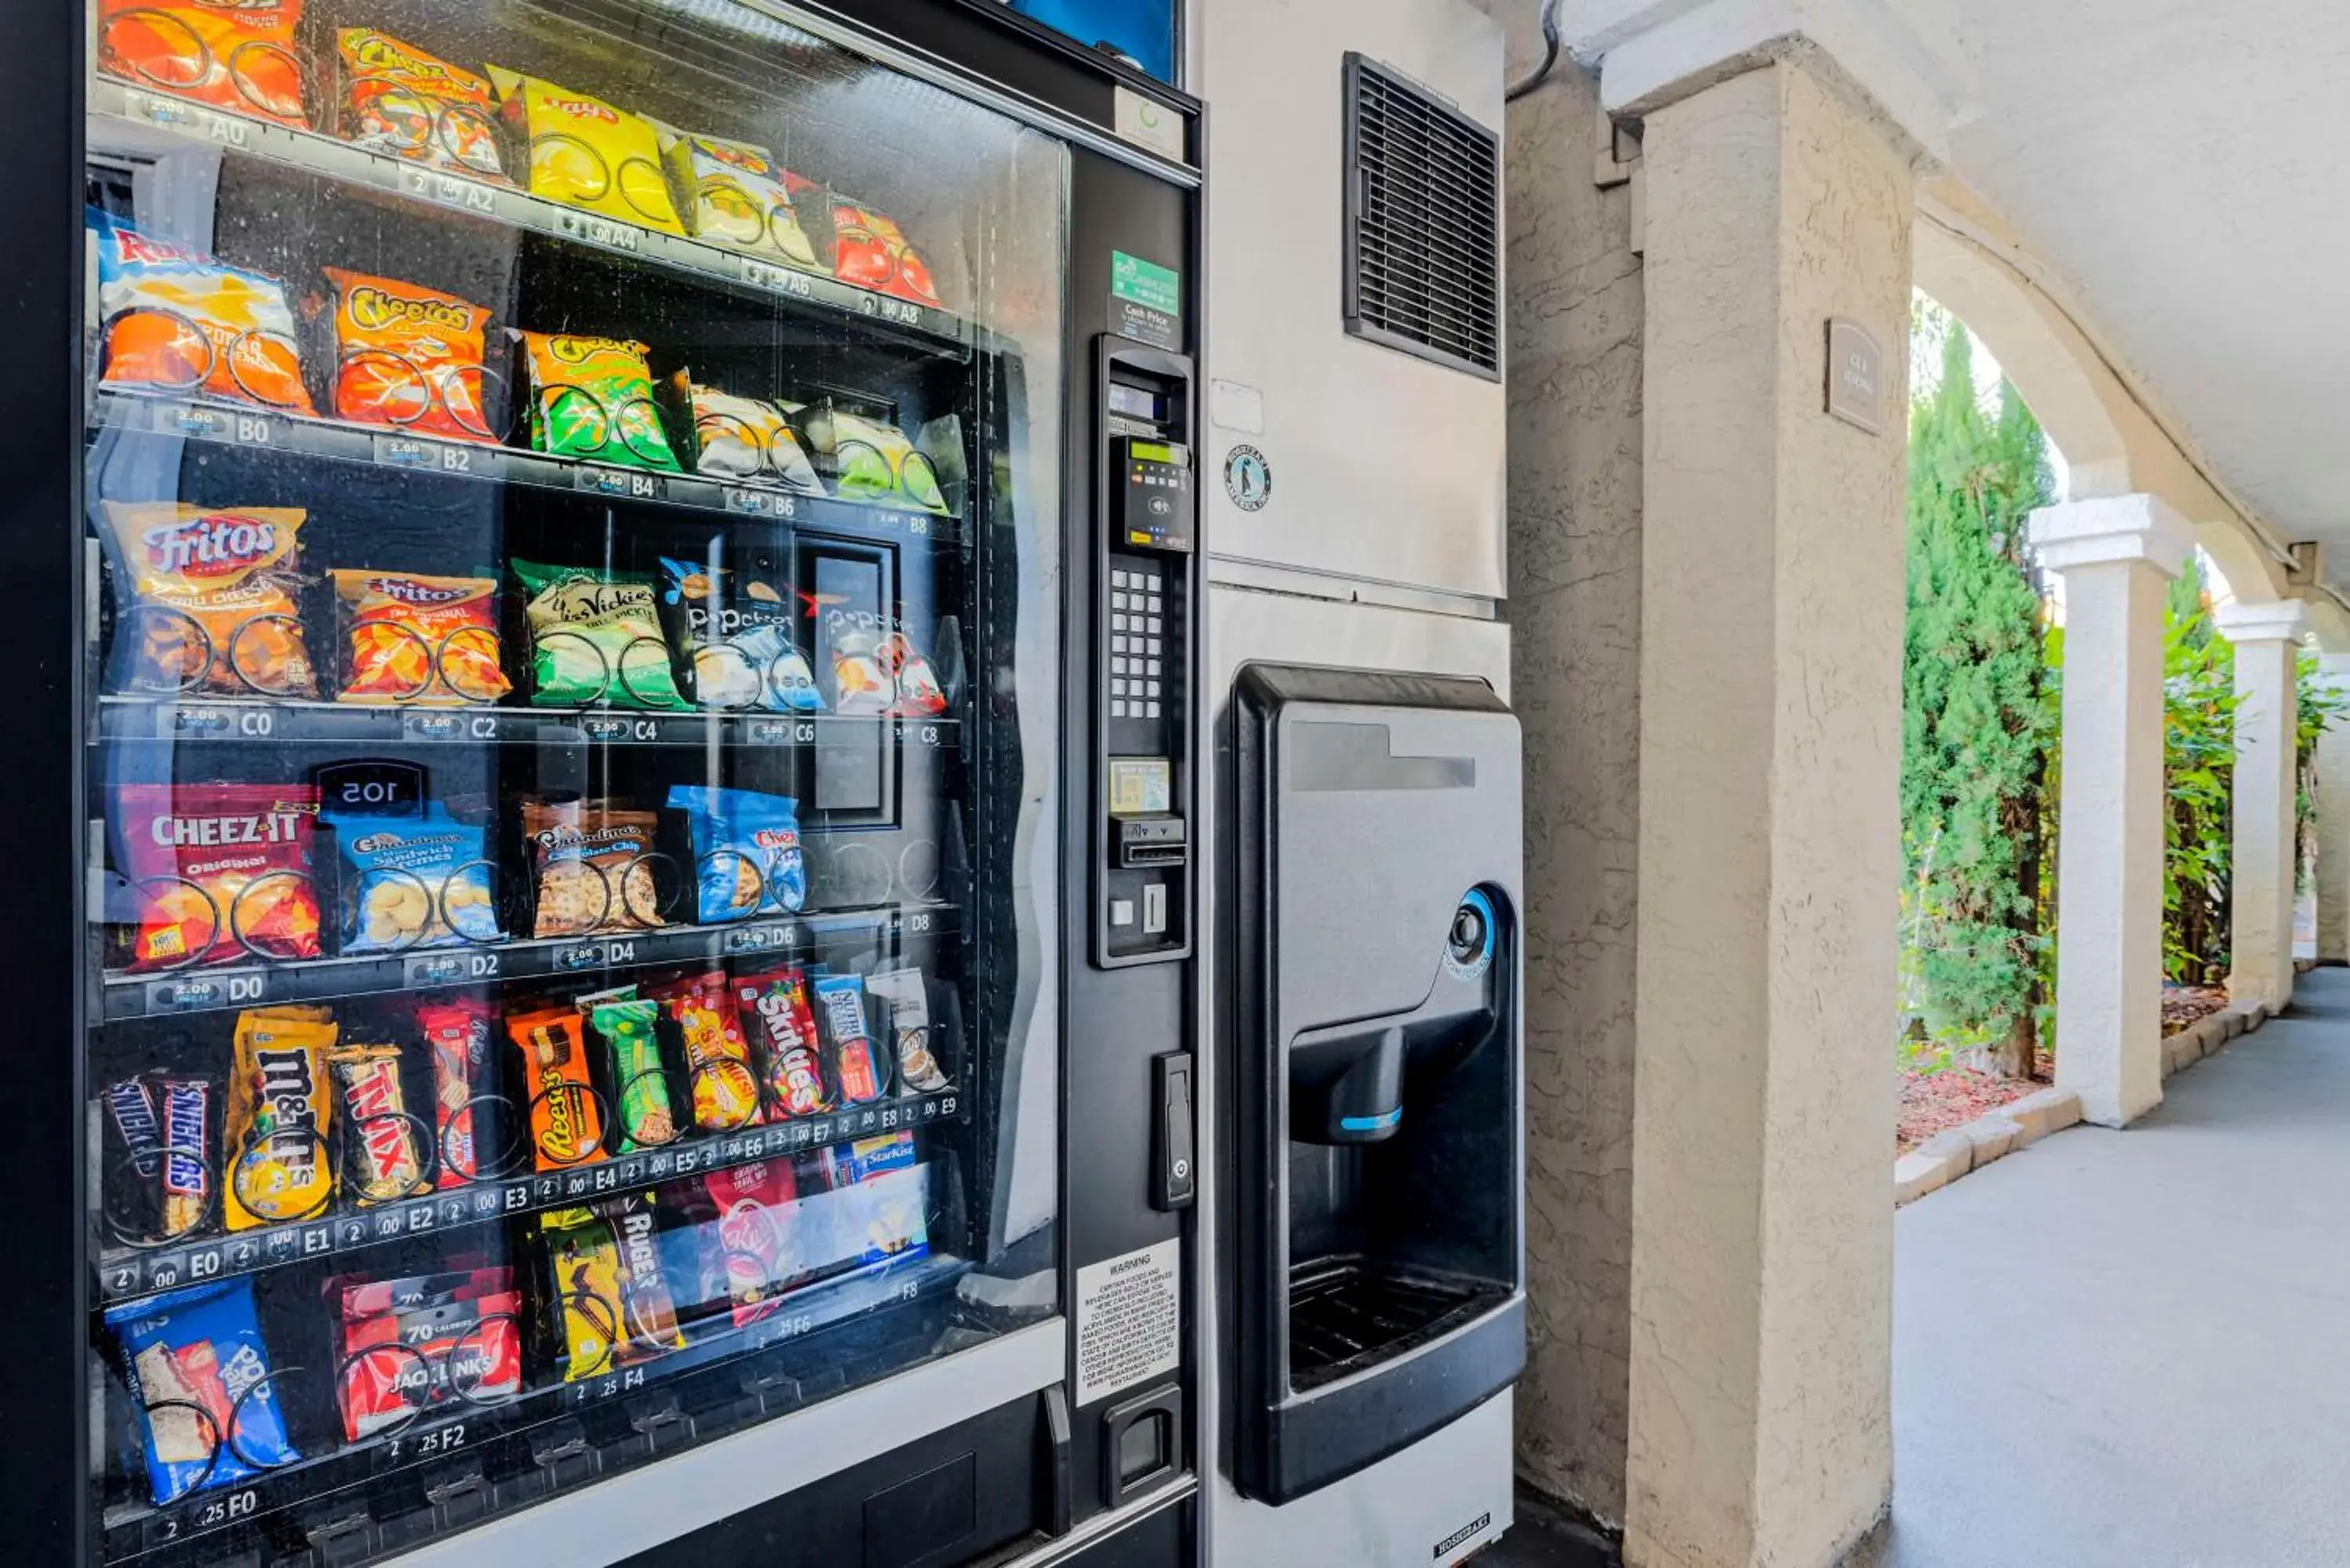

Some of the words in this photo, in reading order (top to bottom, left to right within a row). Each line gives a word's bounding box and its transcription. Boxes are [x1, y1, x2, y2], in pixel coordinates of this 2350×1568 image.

[467, 190, 494, 212] A2
[611, 229, 636, 248] A4
[790, 276, 810, 295] A6
[349, 287, 472, 332] Cheetos
[901, 306, 918, 324] A8
[178, 411, 213, 424] 2.00
[239, 419, 269, 443] B0
[390, 443, 421, 454] 2.00
[444, 450, 470, 471] B2
[632, 476, 654, 497] B4
[775, 497, 795, 516] B6
[909, 516, 927, 535] B8
[142, 518, 276, 573] Fritos
[368, 578, 470, 602] Fritos
[183, 709, 217, 721] 2.00
[240, 712, 273, 736] C0
[423, 717, 451, 728] 2.00
[472, 717, 497, 739] C2
[593, 723, 618, 733] 2.00
[634, 721, 658, 740] C4
[795, 723, 814, 742] C6
[921, 726, 938, 743] C8
[548, 843, 613, 862] Colate
[612, 840, 641, 854] Chip
[186, 855, 267, 875] ORIGINAL
[911, 914, 930, 933] D8
[772, 926, 794, 945] D6
[566, 948, 594, 962] 2.00
[610, 941, 635, 964] D4
[427, 959, 456, 971] 2.00
[472, 954, 499, 977] D2
[175, 983, 211, 995] 2.00
[229, 976, 263, 1001] D0
[841, 991, 861, 1035] NUTRI
[757, 995, 815, 1109] Skittles
[345, 1053, 410, 1180] TWIX
[539, 1067, 576, 1158] Reese's
[844, 1120, 851, 1133] 2
[883, 1108, 898, 1127] E8
[906, 1108, 913, 1121] 2
[942, 1097, 956, 1115] E9
[776, 1131, 784, 1143] 2
[814, 1123, 830, 1143] E7
[705, 1151, 713, 1165] 2
[745, 1138, 763, 1158] E6
[867, 1146, 914, 1165] StarKist
[627, 1163, 636, 1178] 2
[676, 1152, 696, 1172] E5
[541, 1180, 551, 1195] 2
[566, 1177, 586, 1195] .00
[596, 1168, 616, 1190] E4
[450, 1204, 460, 1219] 2
[476, 1193, 497, 1212] .00
[505, 1187, 528, 1209] E3
[350, 1224, 360, 1241] 2
[379, 1216, 401, 1236] .00
[410, 1206, 433, 1230] E2
[239, 1242, 249, 1259] 2
[305, 1227, 331, 1253] E1
[118, 1269, 128, 1288] 2
[152, 1270, 176, 1289] .00
[190, 1251, 220, 1277] E0
[1109, 1253, 1151, 1275] WARNING
[902, 1281, 918, 1300] F8
[407, 1324, 434, 1343] 70
[793, 1315, 812, 1335] F6
[577, 1384, 586, 1400] 2
[601, 1379, 617, 1397] .25
[624, 1366, 645, 1391] F4
[392, 1440, 400, 1457] 2
[418, 1433, 439, 1454] .25
[443, 1425, 465, 1450] F2
[165, 1521, 178, 1540] 2
[201, 1501, 226, 1526] .25
[228, 1490, 257, 1520] F0
